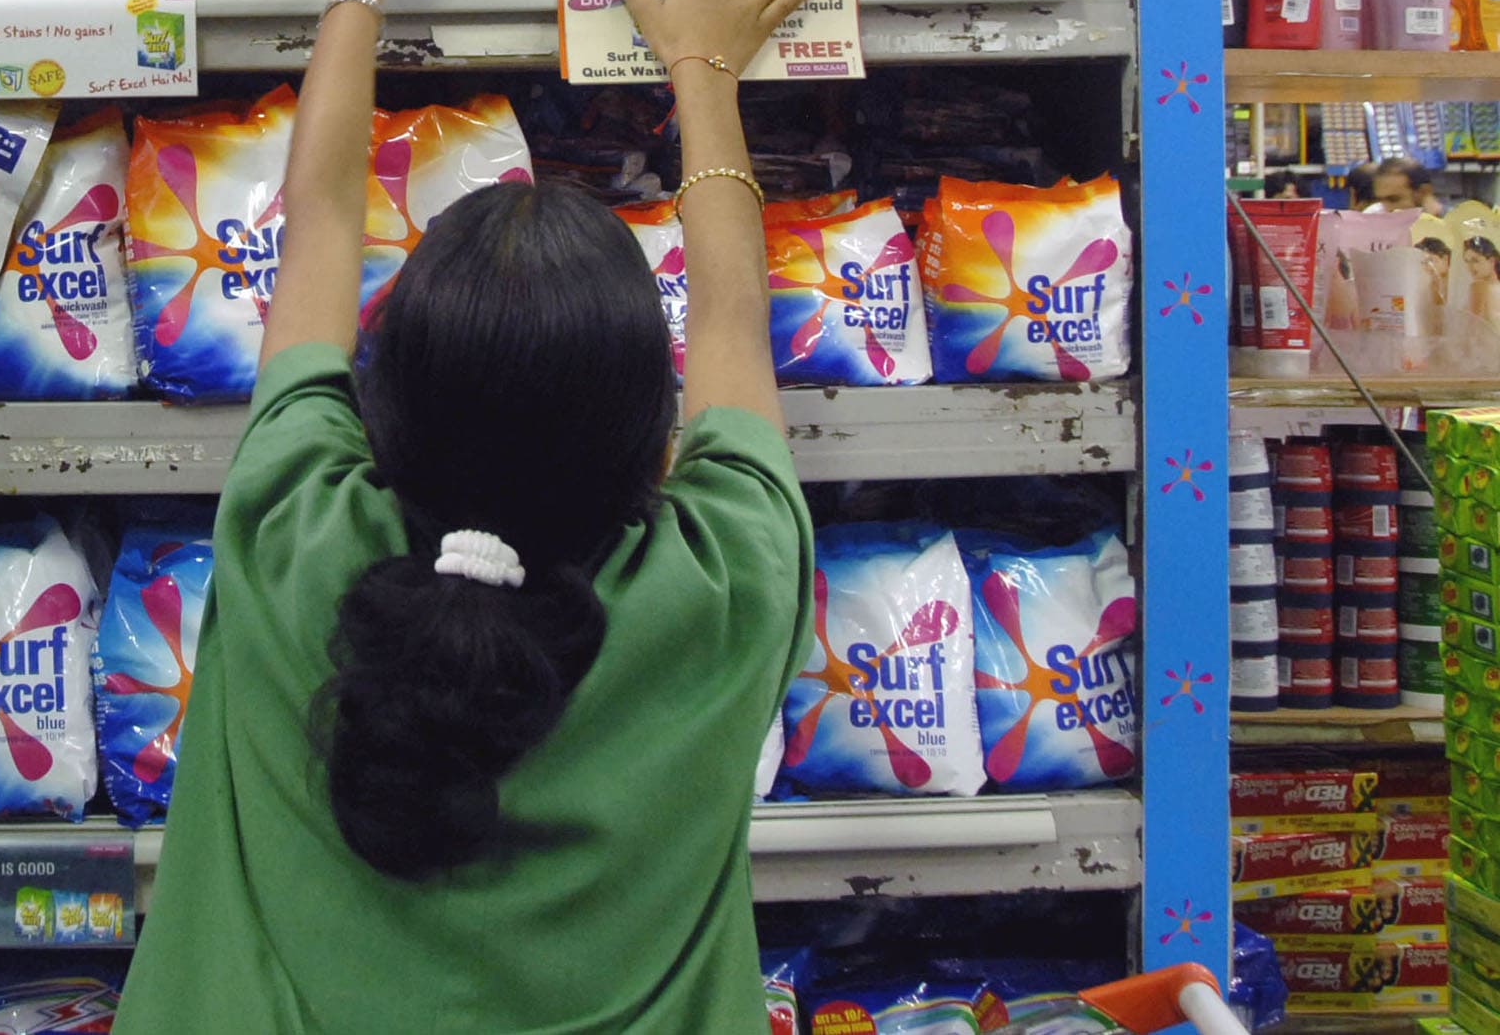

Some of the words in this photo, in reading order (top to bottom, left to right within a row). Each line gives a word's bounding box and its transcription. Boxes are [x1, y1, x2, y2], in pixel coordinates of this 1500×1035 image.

[4, 25, 42, 39] Stains
[53, 25, 71, 38] No
[75, 25, 106, 41] gains
[606, 51, 639, 63] Surf
[27, 67, 65, 86] SAFE
[582, 66, 626, 79] Quick
[788, 63, 811, 73] FOOD
[88, 79, 116, 94] Surf
[119, 76, 148, 90] Excel
[151, 73, 170, 86] Hai
[17, 219, 106, 266] Surf
[18, 264, 108, 303] excel
[839, 261, 911, 303] Surf
[1026, 273, 1106, 316] Surf
[54, 300, 108, 315] quickwash
[842, 303, 909, 330] excel
[1027, 309, 1102, 344] excel
[846, 642, 946, 692] Surf
[848, 692, 945, 729] excel
[36, 716, 66, 731] blue
[917, 731, 946, 747] blue
[1, 862, 14, 875] IS
[18, 861, 55, 876] GOOD
